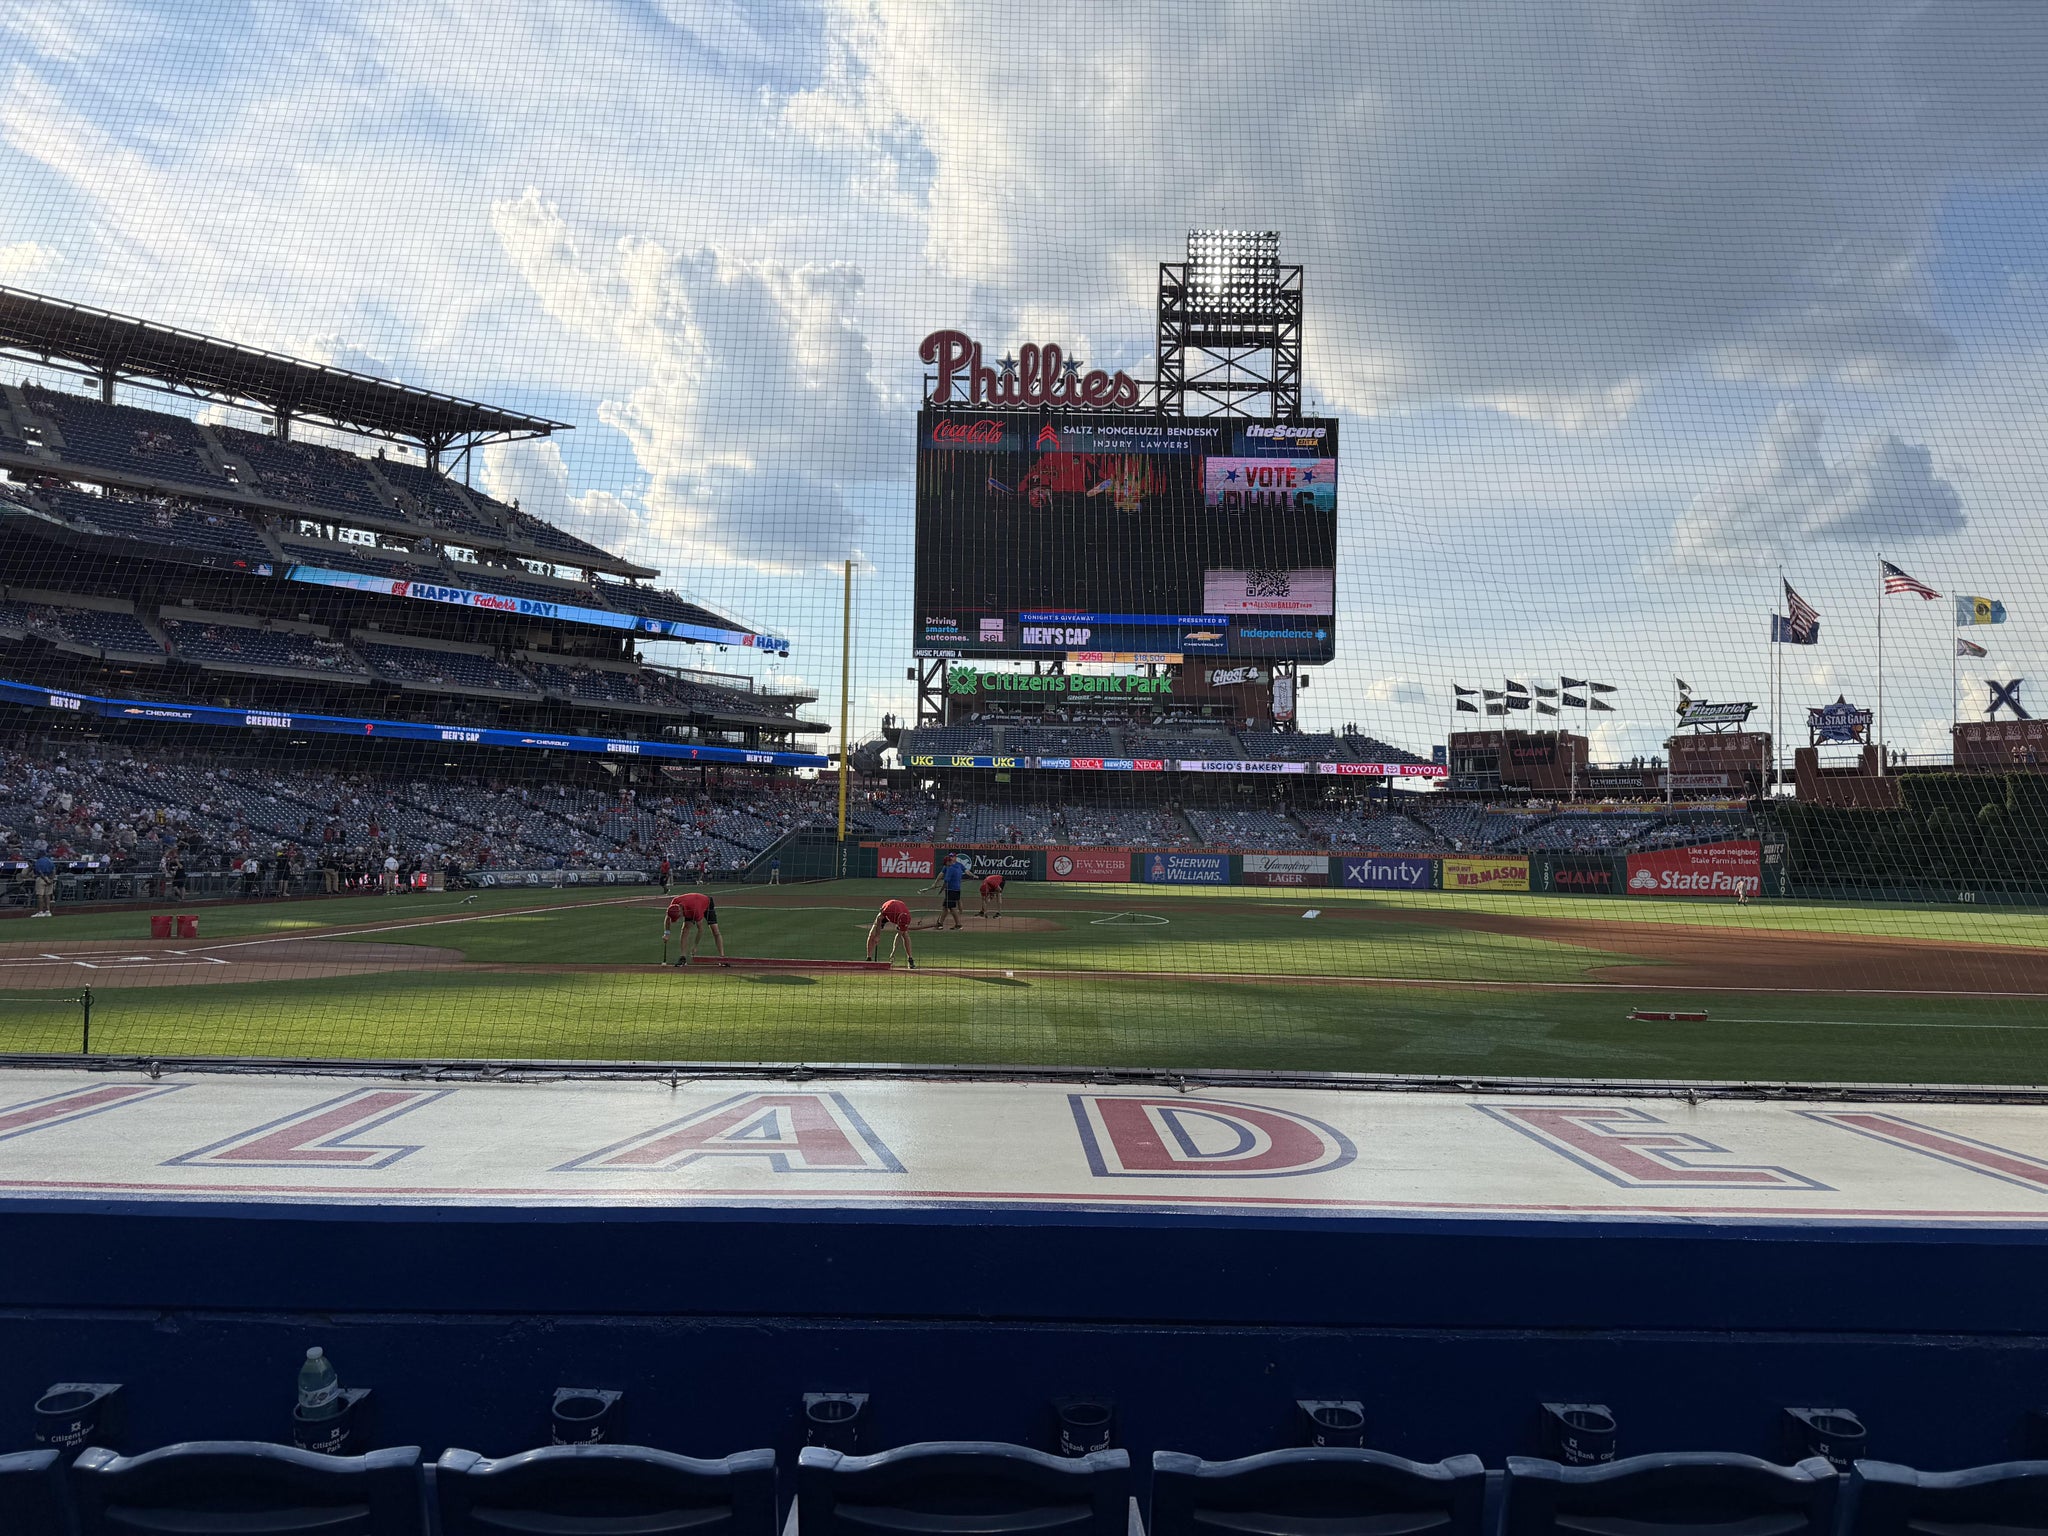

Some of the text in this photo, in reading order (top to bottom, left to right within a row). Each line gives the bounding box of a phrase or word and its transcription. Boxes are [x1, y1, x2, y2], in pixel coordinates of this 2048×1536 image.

[919, 329, 1140, 407] Phillies
[1063, 426, 1219, 437] SALTZ MONGELUZZI BENDESKY
[1246, 424, 1326, 438] theScore
[1093, 440, 1189, 449] INJURY LAWYERS
[1244, 466, 1297, 488] VOTE
[412, 584, 558, 617] HAPPY Father's DAY!
[925, 617, 957, 626] Driving
[1022, 627, 1091, 646] MEN'S CAP
[1240, 628, 1312, 640] Independence
[933, 650, 956, 658] PLAYING)
[1212, 666, 1249, 685] GHOST
[982, 672, 1172, 693] Citizens Bank Park
[50, 696, 80, 710] MEN'S CAP
[1984, 678, 2032, 719] X
[146, 710, 192, 718] CHEVROLET
[1683, 701, 1747, 717] Fitzpatrick
[246, 715, 292, 728] CHEVROLET
[1808, 714, 1872, 726] ALL STAR GAME
[442, 731, 480, 742] MEN'S CAP
[607, 743, 640, 754] CHEVROLET
[1514, 748, 1551, 757] GIANT
[746, 754, 762, 762] MEN'S
[910, 756, 934, 766] UKG
[952, 756, 974, 766] UKG
[992, 758, 1015, 767] UKG
[1074, 760, 1100, 768] NECA
[1136, 760, 1162, 770] NECA
[1202, 762, 1284, 772] LISCIO'S BAKERY
[1340, 764, 1380, 774] TOYOTA
[1404, 765, 1444, 774] TOYOTA
[1709, 848, 1726, 856] good
[1727, 848, 1758, 856] neighbor,
[881, 858, 931, 874] Wawa
[972, 855, 1031, 868] NovaCare
[1076, 860, 1125, 870] F.W. WEBB
[1168, 856, 1220, 868] SHERWIN
[1259, 856, 1313, 872] Yuengling
[568, 872, 578, 882] 10
[1348, 859, 1424, 884] xfinity
[528, 873, 538, 883] 10
[1268, 874, 1302, 884] LAGER
[1554, 872, 1612, 884] GIANT
[1958, 892, 1975, 902] 401
[51, 1432, 81, 1443] Citizens
[66, 1438, 82, 1447] Park
